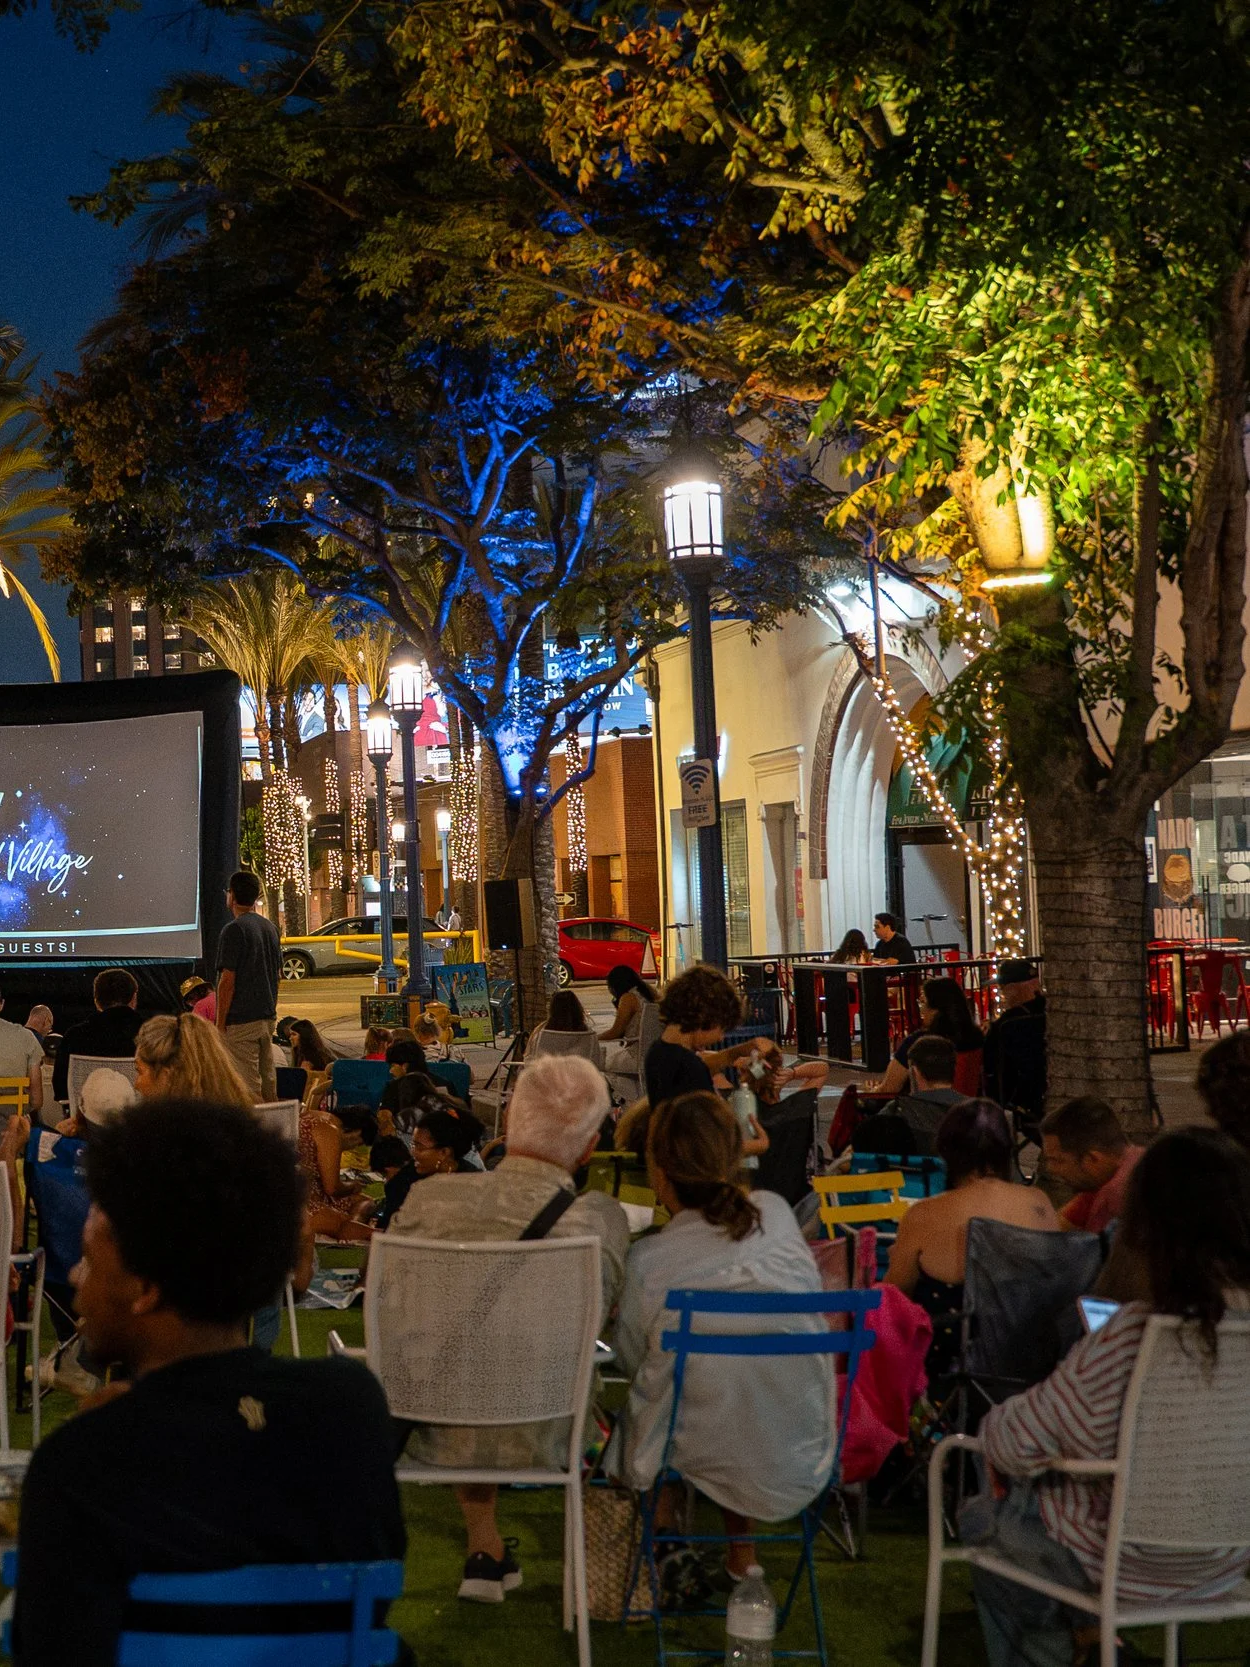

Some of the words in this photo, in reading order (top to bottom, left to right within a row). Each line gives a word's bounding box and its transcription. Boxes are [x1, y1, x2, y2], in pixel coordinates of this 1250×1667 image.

[688, 804, 708, 815] FREE
[6, 838, 94, 893] Village
[459, 982, 485, 995] STARS
